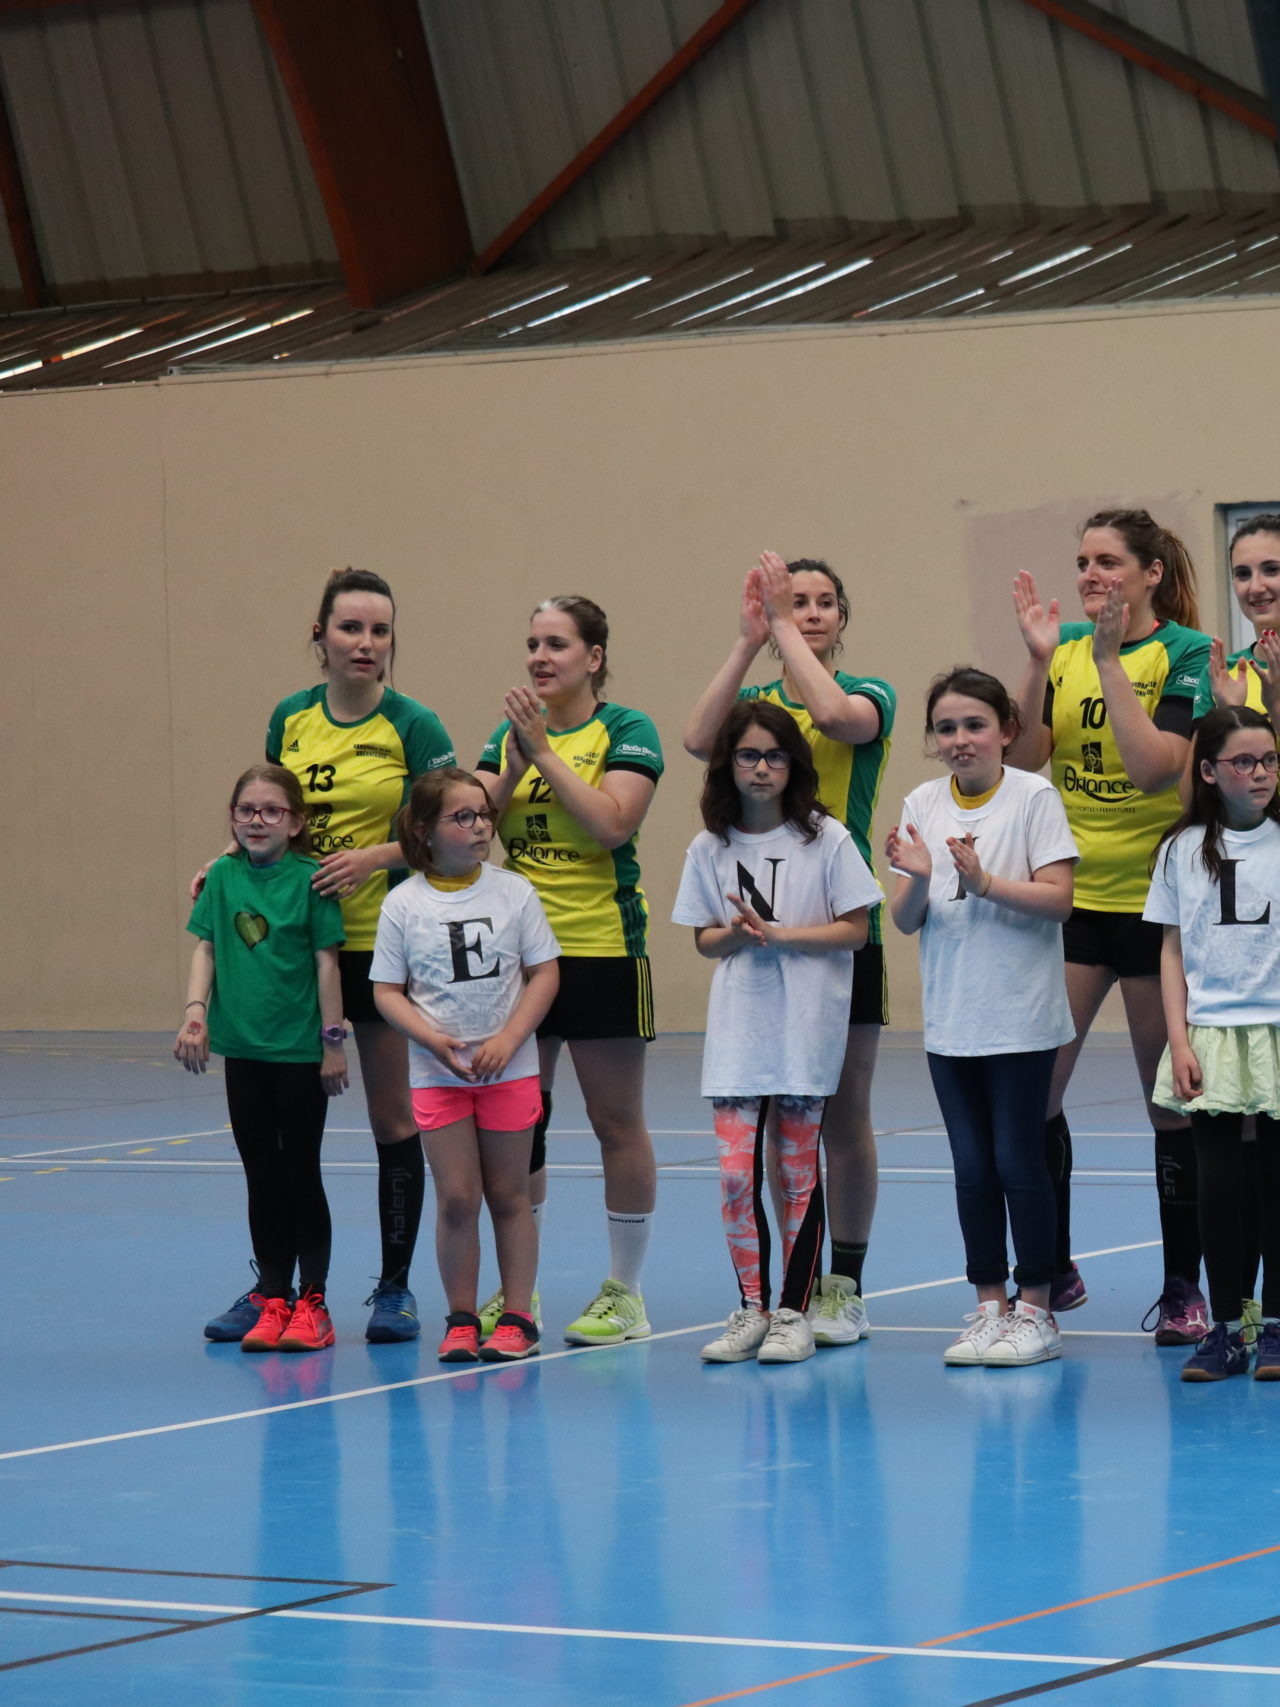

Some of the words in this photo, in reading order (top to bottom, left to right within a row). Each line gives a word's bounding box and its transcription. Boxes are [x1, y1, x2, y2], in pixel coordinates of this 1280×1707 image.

[1079, 697, 1108, 730] 10
[306, 763, 336, 793] 13
[528, 776, 552, 804] 12
[312, 833, 353, 849] ance
[737, 857, 786, 922] N
[1212, 859, 1271, 926] L
[439, 916, 500, 984] E
